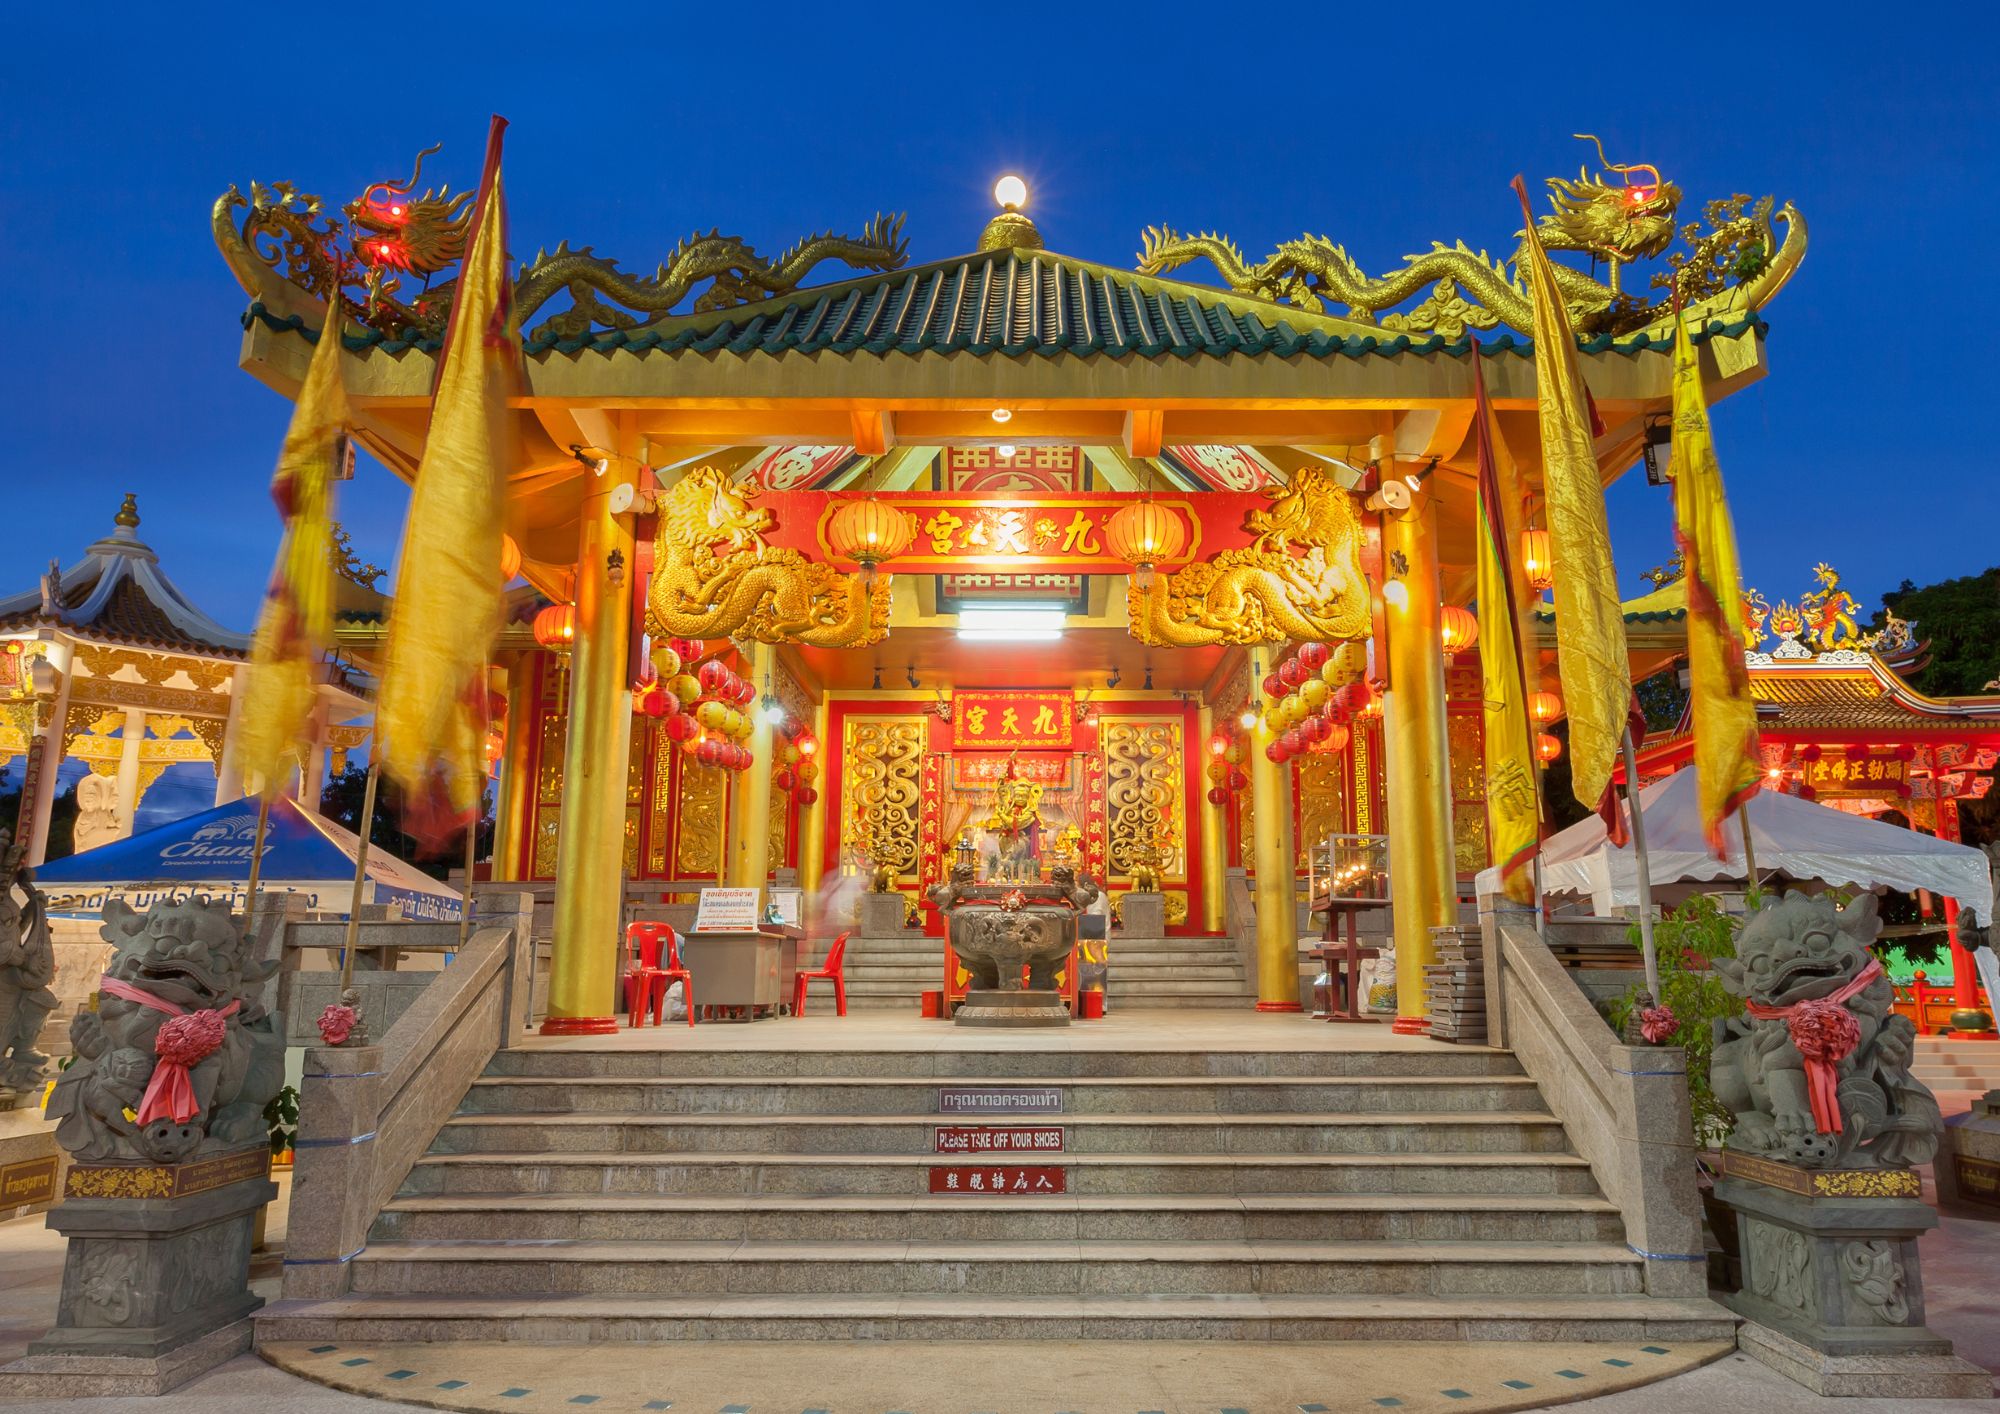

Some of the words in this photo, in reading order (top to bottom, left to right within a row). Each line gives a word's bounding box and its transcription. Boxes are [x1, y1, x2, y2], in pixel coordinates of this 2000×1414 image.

[159, 841, 275, 860] Chang
[944, 1090, 1058, 1110] กรุณาถอดรองเท้า
[939, 1133, 968, 1148] PLEASE
[971, 1133, 991, 1148] TAKE
[993, 1132, 1009, 1148] OFF
[1010, 1132, 1032, 1148] YOUR
[1034, 1131, 1060, 1147] SHOES
